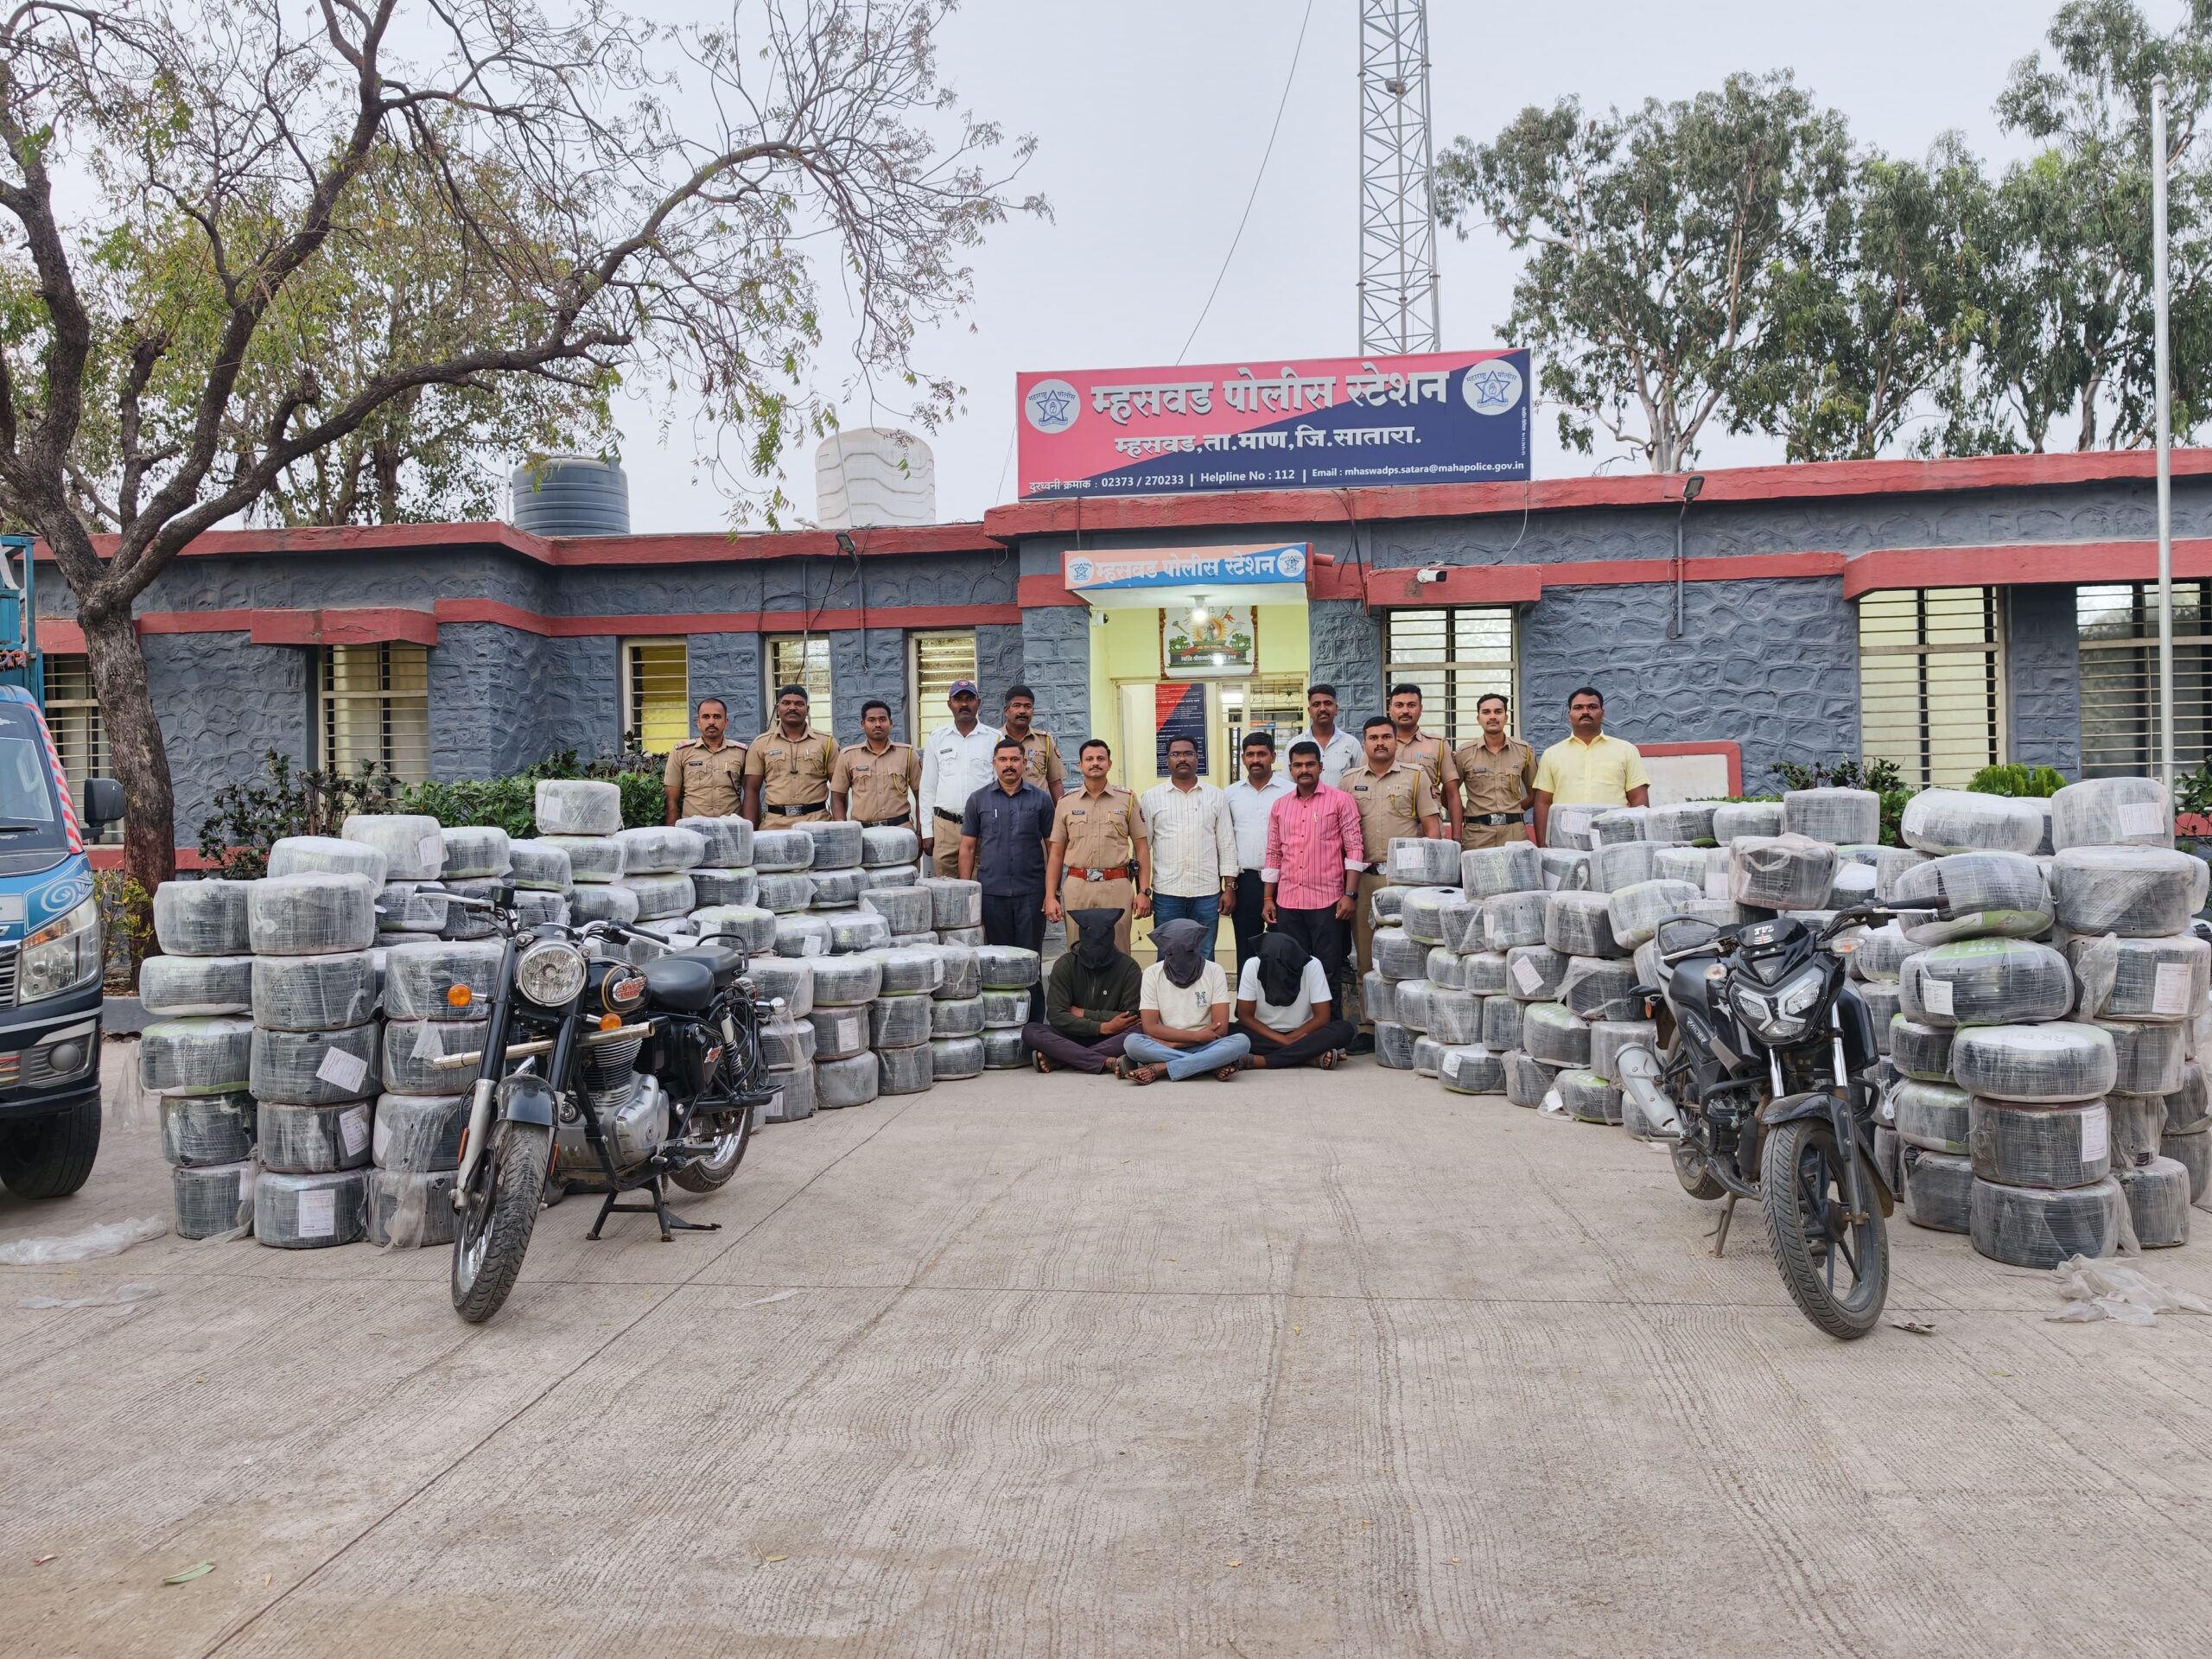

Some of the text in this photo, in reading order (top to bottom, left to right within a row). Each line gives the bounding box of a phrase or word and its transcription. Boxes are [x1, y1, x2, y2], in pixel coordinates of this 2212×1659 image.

[1091, 361, 1451, 425] म्हसवड पोलीस स्टेशन
[1101, 476, 1134, 487] 02373
[1145, 474, 1185, 486] 270233
[1200, 471, 1246, 485] Helpline
[1249, 471, 1266, 480] No
[1274, 469, 1295, 480] 112
[1312, 467, 1338, 477] Email
[1344, 461, 1524, 475] mhaswadps.satara@mahapolice.gov.in
[1161, 553, 1218, 577] पोलीस
[1224, 550, 1276, 576] स्टेशन
[1687, 1016, 1709, 1044] RAIDER
